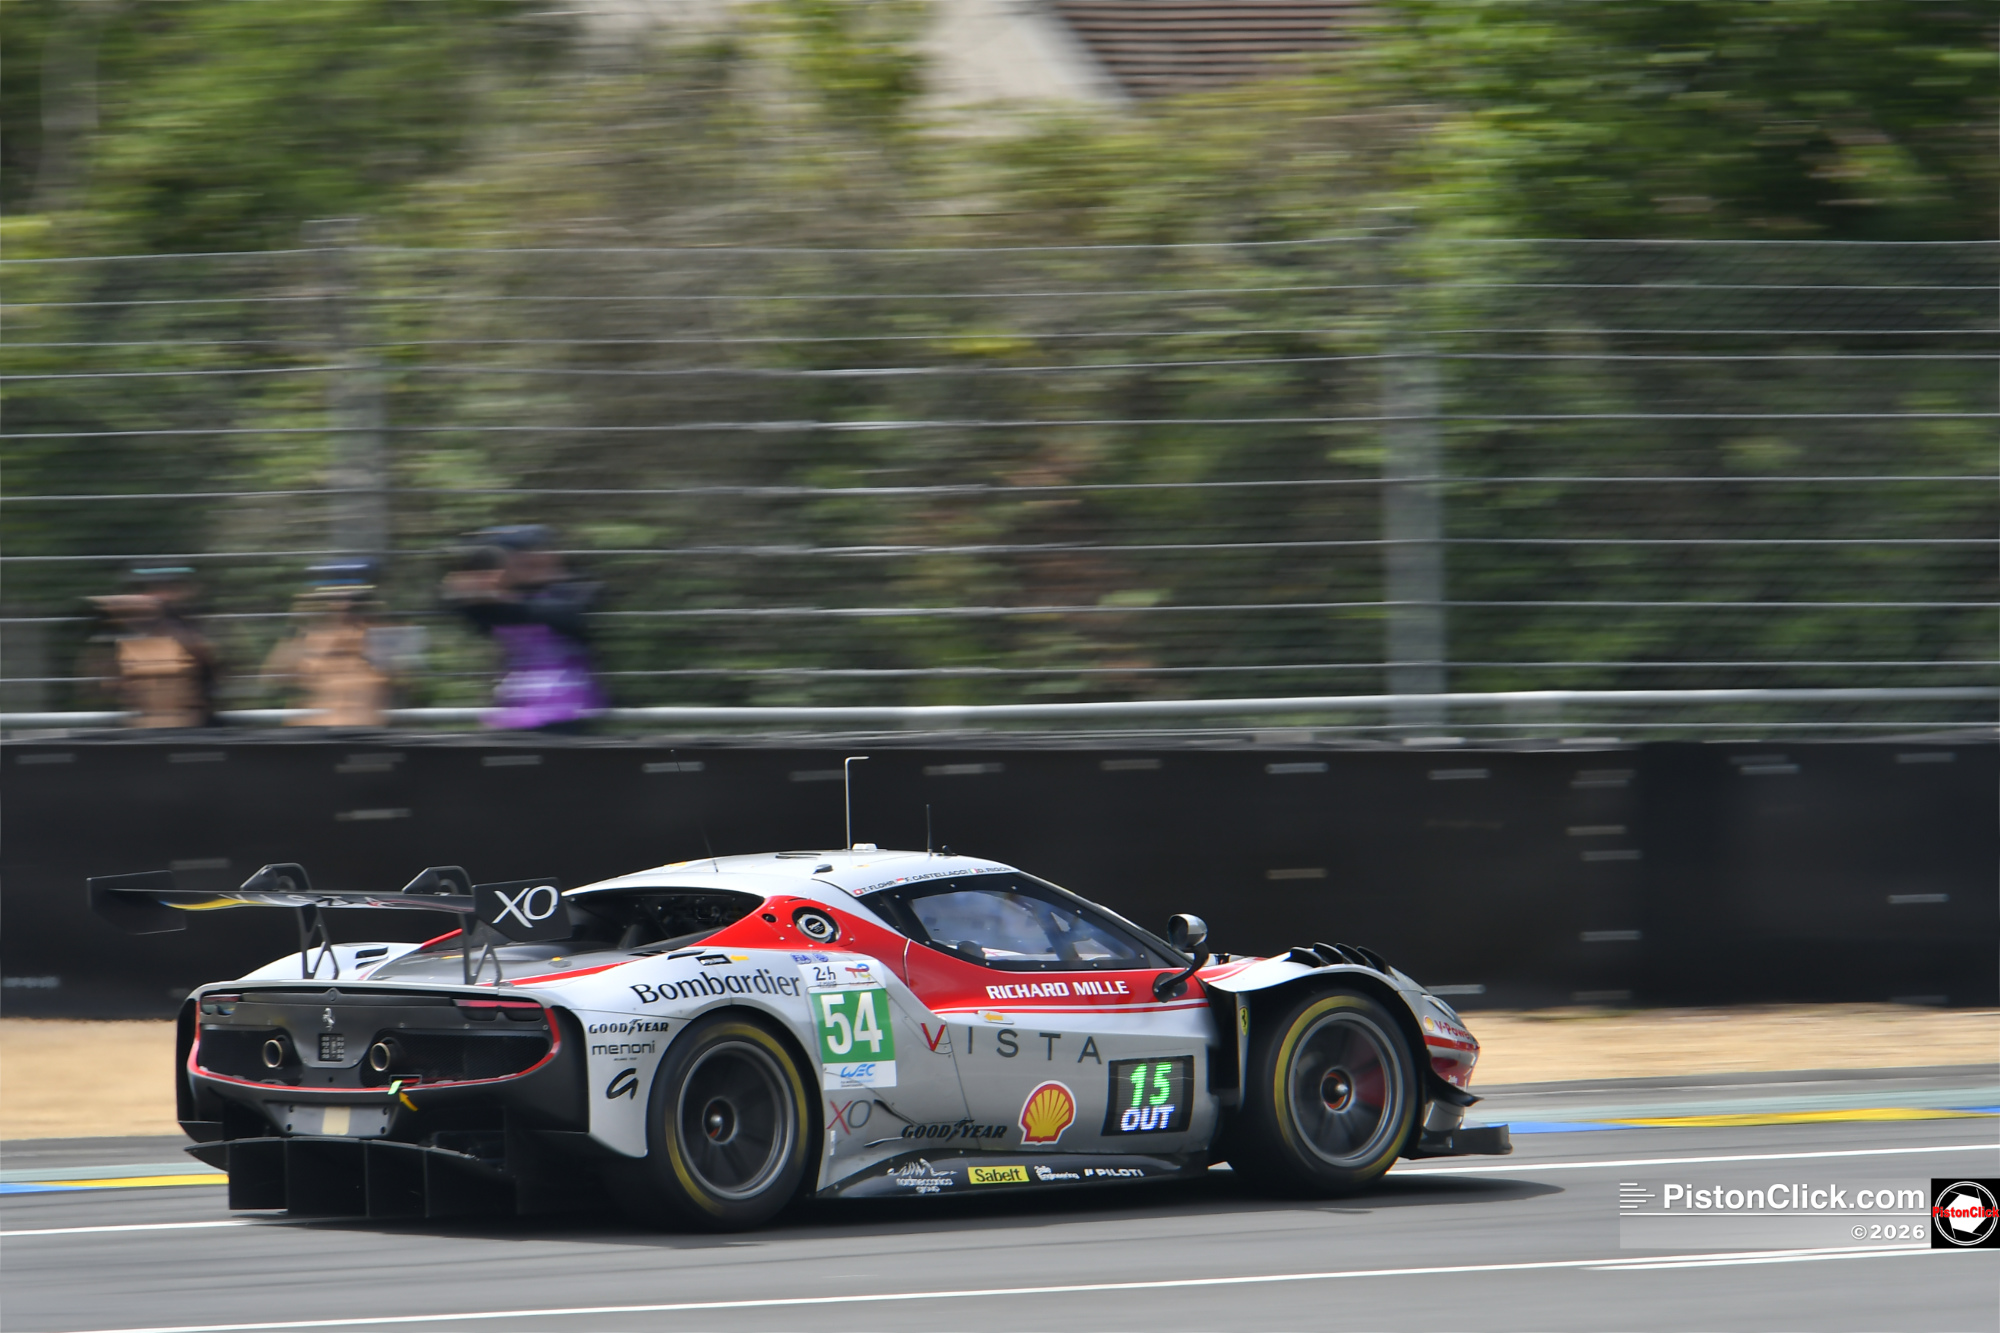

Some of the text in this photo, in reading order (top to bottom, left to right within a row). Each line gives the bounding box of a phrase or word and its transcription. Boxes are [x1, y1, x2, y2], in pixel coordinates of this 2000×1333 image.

[493, 885, 558, 928] XO
[629, 969, 800, 1004] Bombardier
[986, 981, 1130, 1000] RICHARD MILLE
[589, 1019, 669, 1035] GOODYEAR
[820, 992, 883, 1054] 54
[592, 1040, 655, 1055] menoni
[921, 1023, 1102, 1064] VISTA
[1130, 1063, 1173, 1107] 15
[826, 1100, 873, 1135] XO
[901, 1119, 1007, 1142] GOODYEAR
[1120, 1105, 1175, 1132] OUT
[974, 1168, 1023, 1183] Sabelt
[1095, 1168, 1145, 1177] PILOTI
